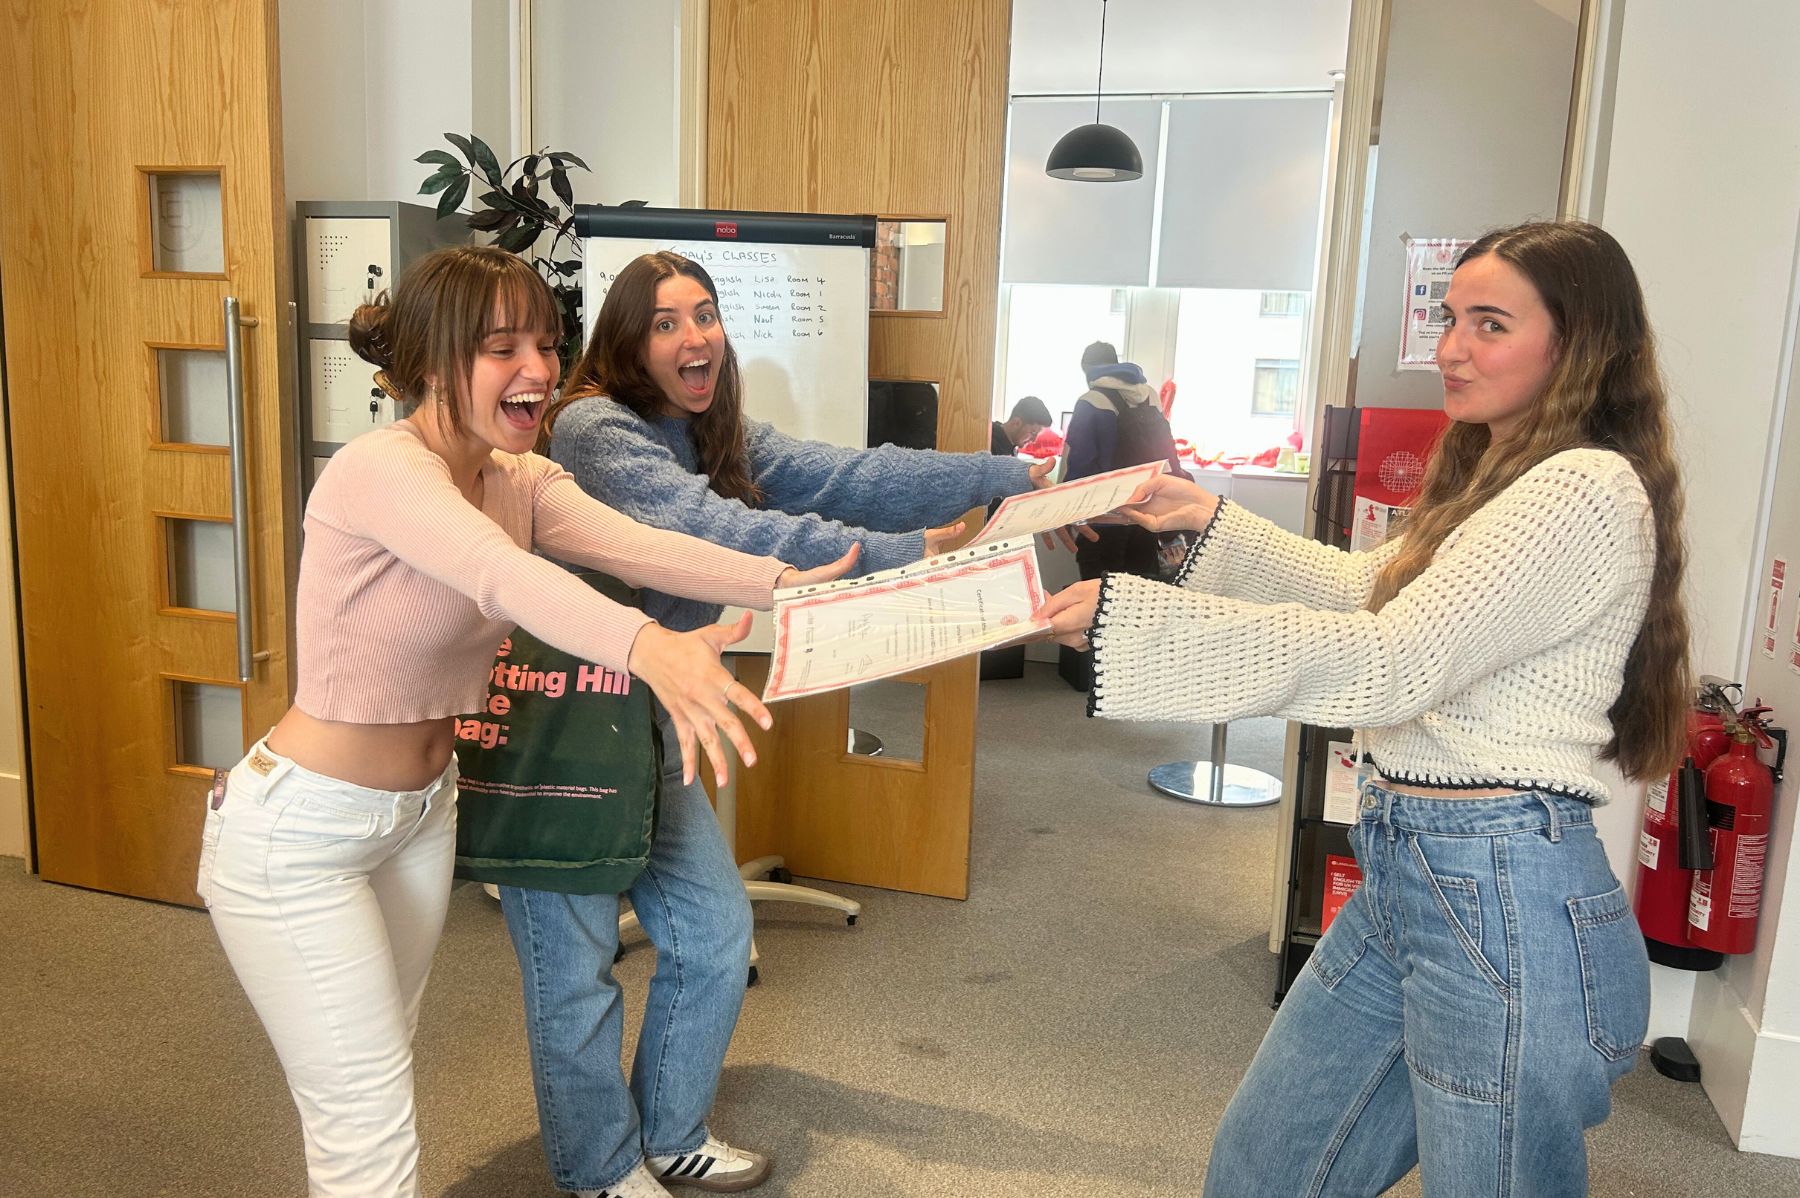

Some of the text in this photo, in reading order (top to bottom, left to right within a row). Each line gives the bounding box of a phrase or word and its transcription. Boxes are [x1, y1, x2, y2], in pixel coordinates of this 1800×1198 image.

[716, 227, 737, 235] nobo
[722, 250, 777, 263] CLASSES
[754, 274, 775, 284] Lisa
[787, 275, 809, 284] Room
[816, 275, 826, 286] 4
[717, 289, 741, 299] nglish
[790, 289, 811, 299] Room
[719, 303, 745, 312] nglish
[791, 302, 811, 312] Room
[816, 304, 827, 312] 2
[791, 315, 813, 323] Room
[818, 315, 825, 323] 5
[753, 329, 773, 340] Nick
[792, 329, 811, 338] Room
[489, 661, 631, 698] tting Hill
